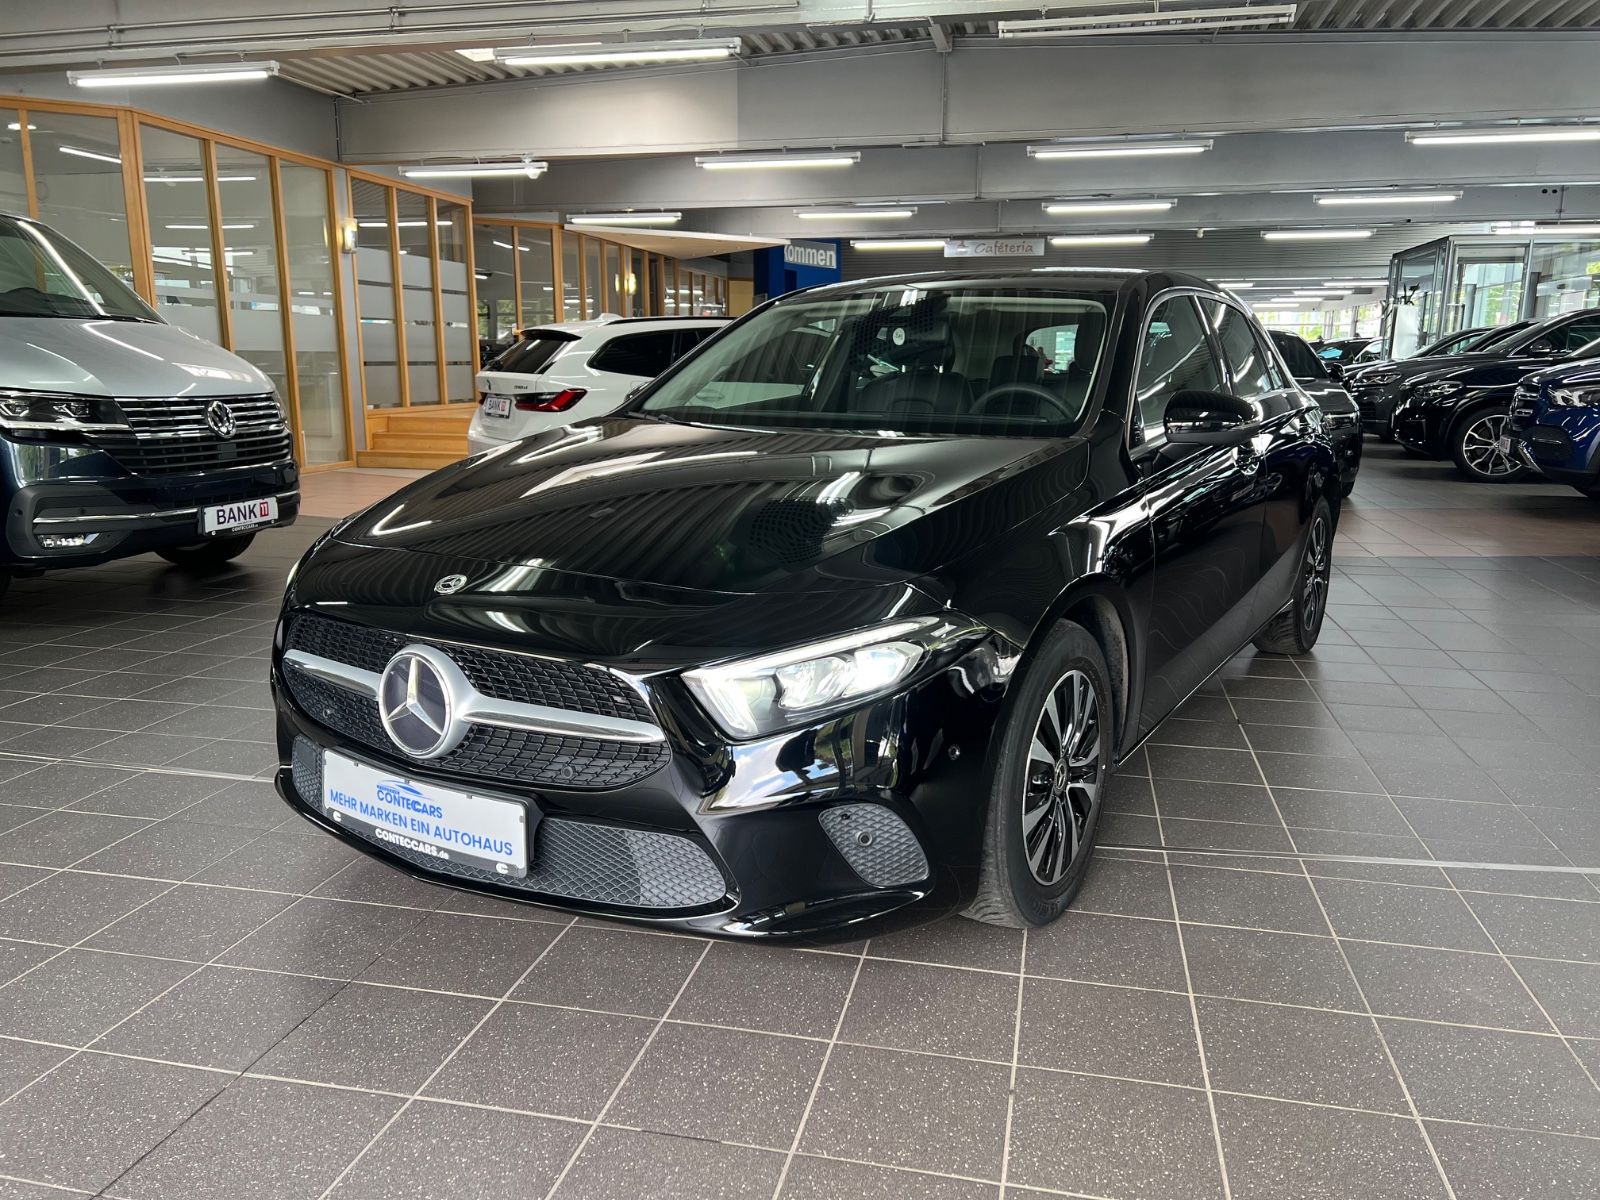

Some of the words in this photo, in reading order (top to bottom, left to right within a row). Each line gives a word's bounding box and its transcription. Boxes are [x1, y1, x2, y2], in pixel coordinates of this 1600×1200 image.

[216, 503, 258, 525] BANK
[329, 788, 357, 811] MEHR
[359, 800, 408, 832] MARKEN
[410, 818, 430, 836] EIN
[433, 825, 513, 856] AUTOHAUS
